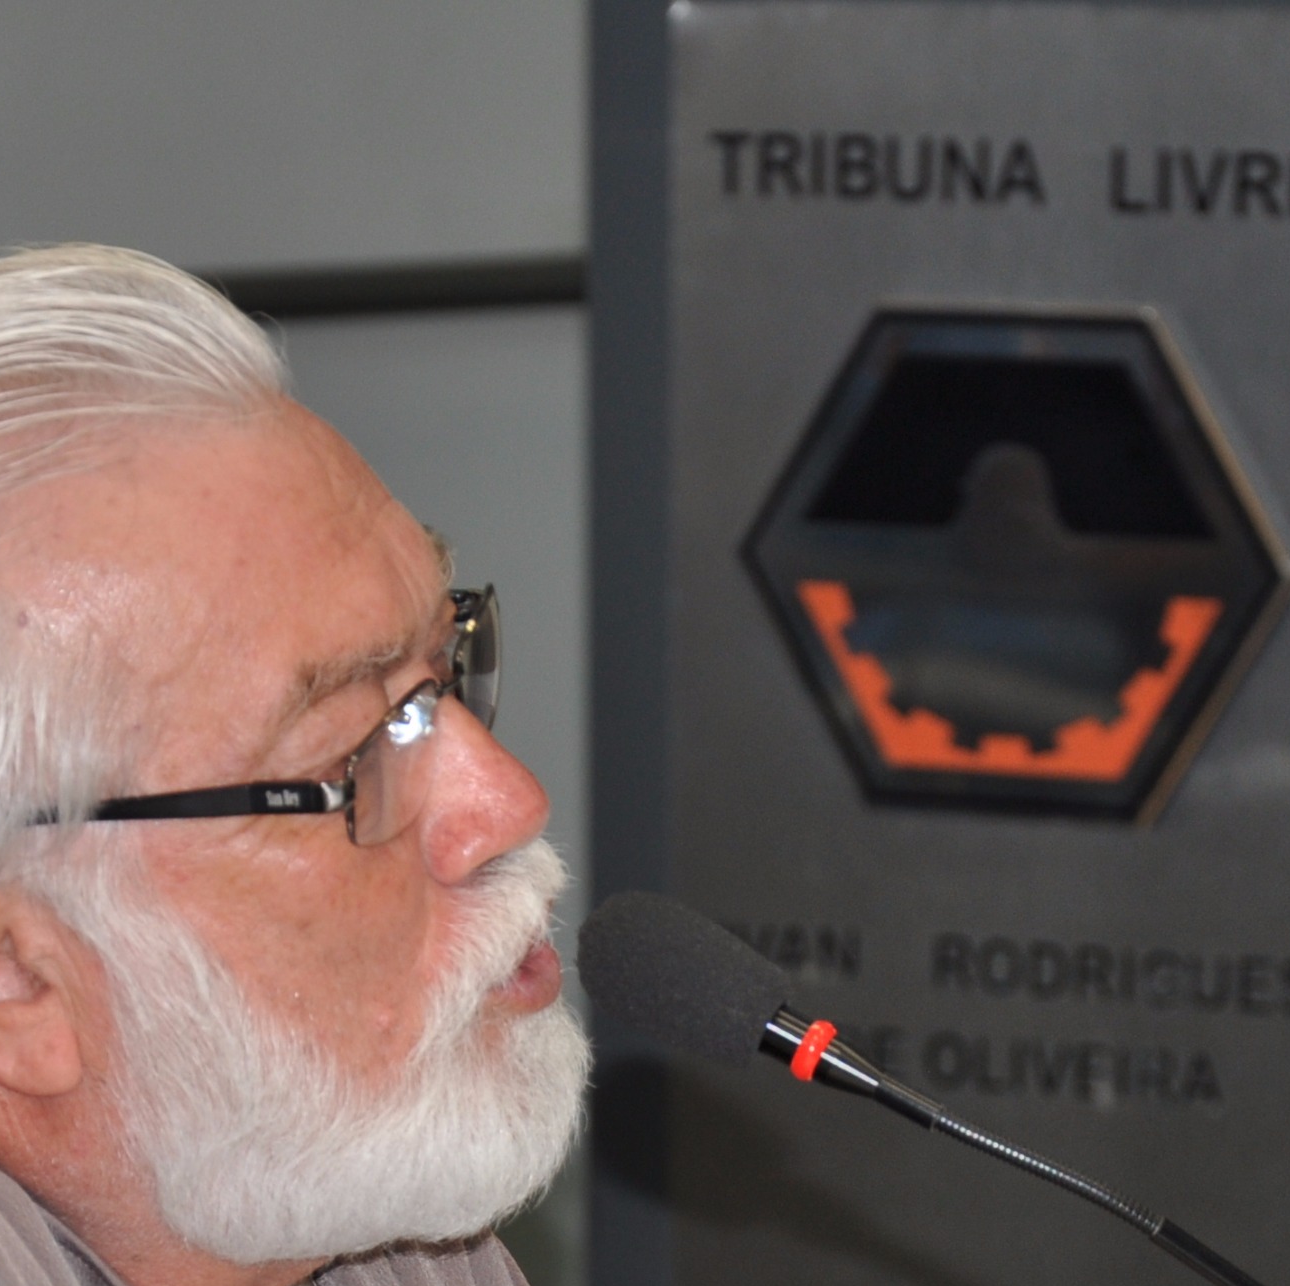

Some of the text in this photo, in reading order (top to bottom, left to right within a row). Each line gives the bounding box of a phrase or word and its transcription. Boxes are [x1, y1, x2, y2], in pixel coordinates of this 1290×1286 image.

[709, 129, 1048, 207] TRIBUNA
[720, 921, 863, 980] VAN
[922, 1028, 1222, 1105] OLIVEIRA
